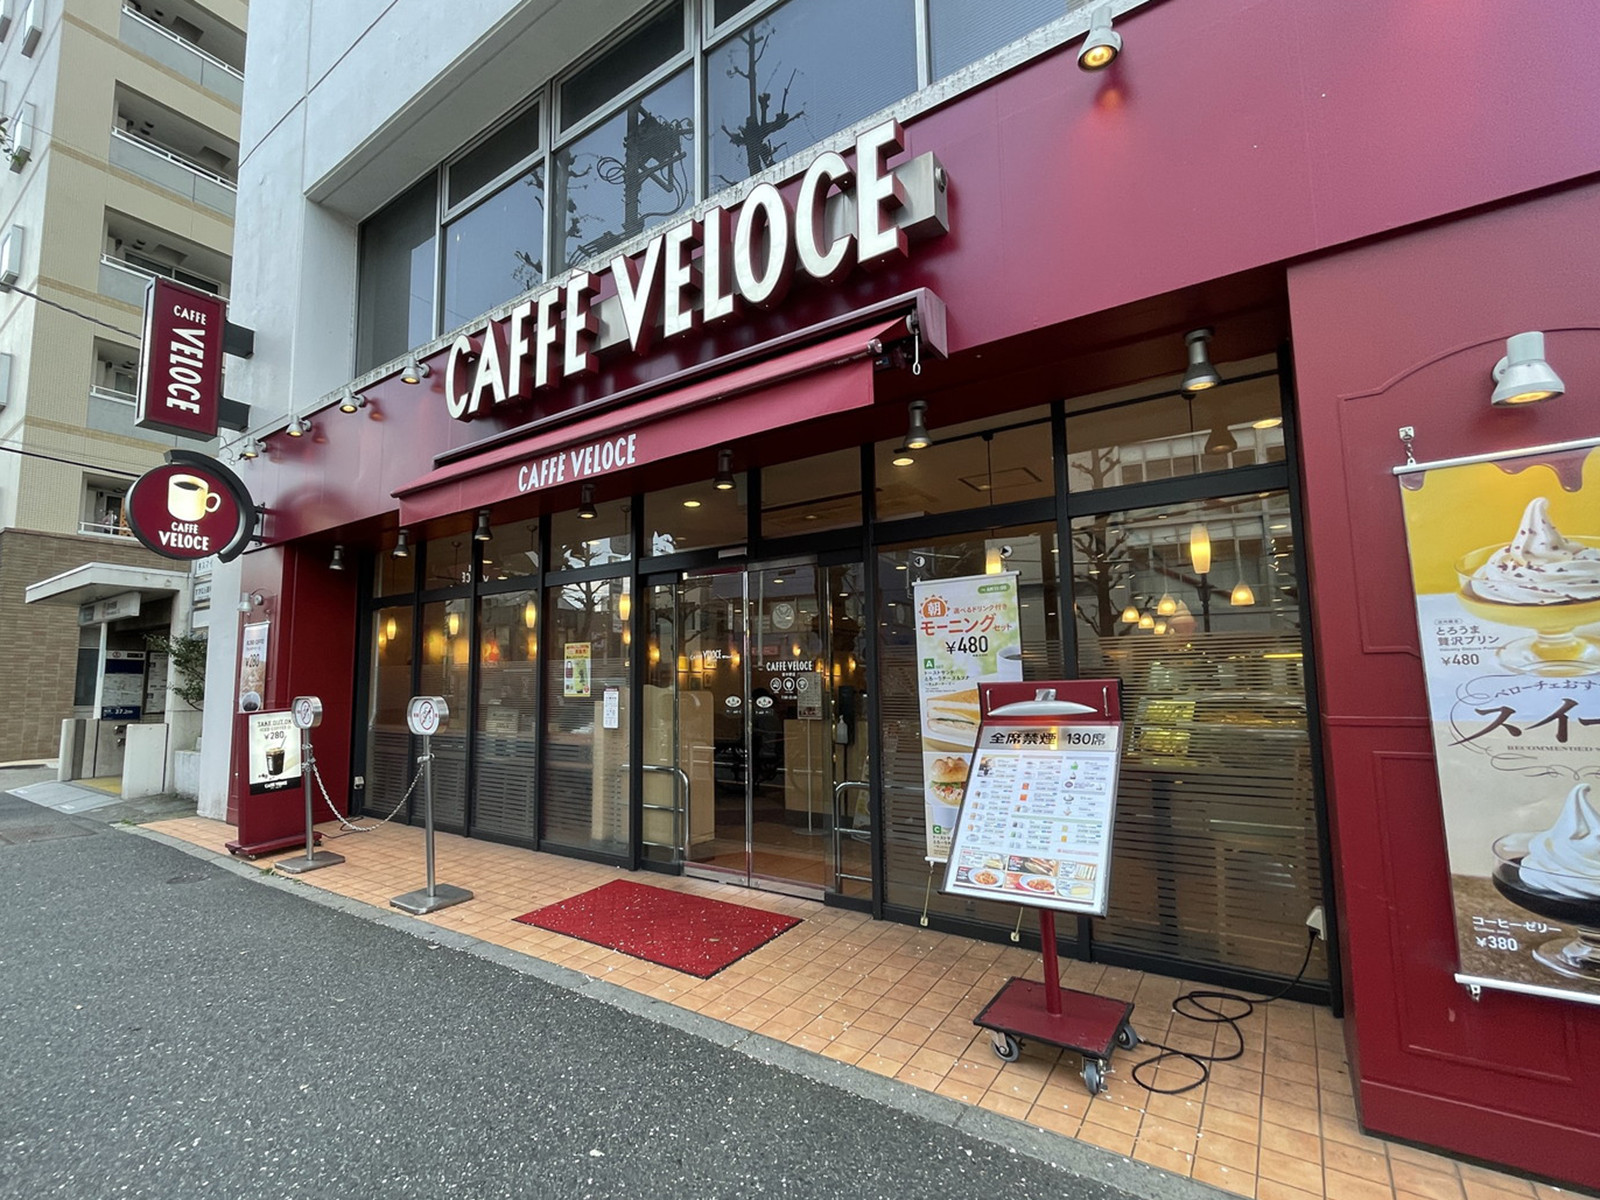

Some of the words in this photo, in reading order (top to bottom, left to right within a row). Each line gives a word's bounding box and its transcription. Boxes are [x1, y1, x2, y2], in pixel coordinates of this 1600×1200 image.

[611, 118, 905, 352] VELOCE
[166, 328, 206, 415] VELOCE
[518, 452, 566, 492] CAFFÈ
[571, 433, 636, 477] VELOCE
[158, 530, 209, 551] VELOCE
[927, 601, 942, 617] 朝
[920, 612, 1012, 637] モーニングセット
[1436, 625, 1481, 636] とろうま
[945, 635, 989, 655] ¥480
[1437, 635, 1500, 647] 贅沢プリン
[787, 660, 812, 672] VELOCE
[1441, 653, 1480, 666] ¥480
[1494, 679, 1600, 698] ベローチェおす
[263, 730, 285, 741] ¥280
[989, 732, 1056, 745] 全席禁煙
[1066, 733, 1106, 746] 130席
[1507, 744, 1592, 752] RECOMMENDED
[1472, 916, 1562, 933] コーヒーゼリー
[1476, 936, 1518, 951] ¥380
